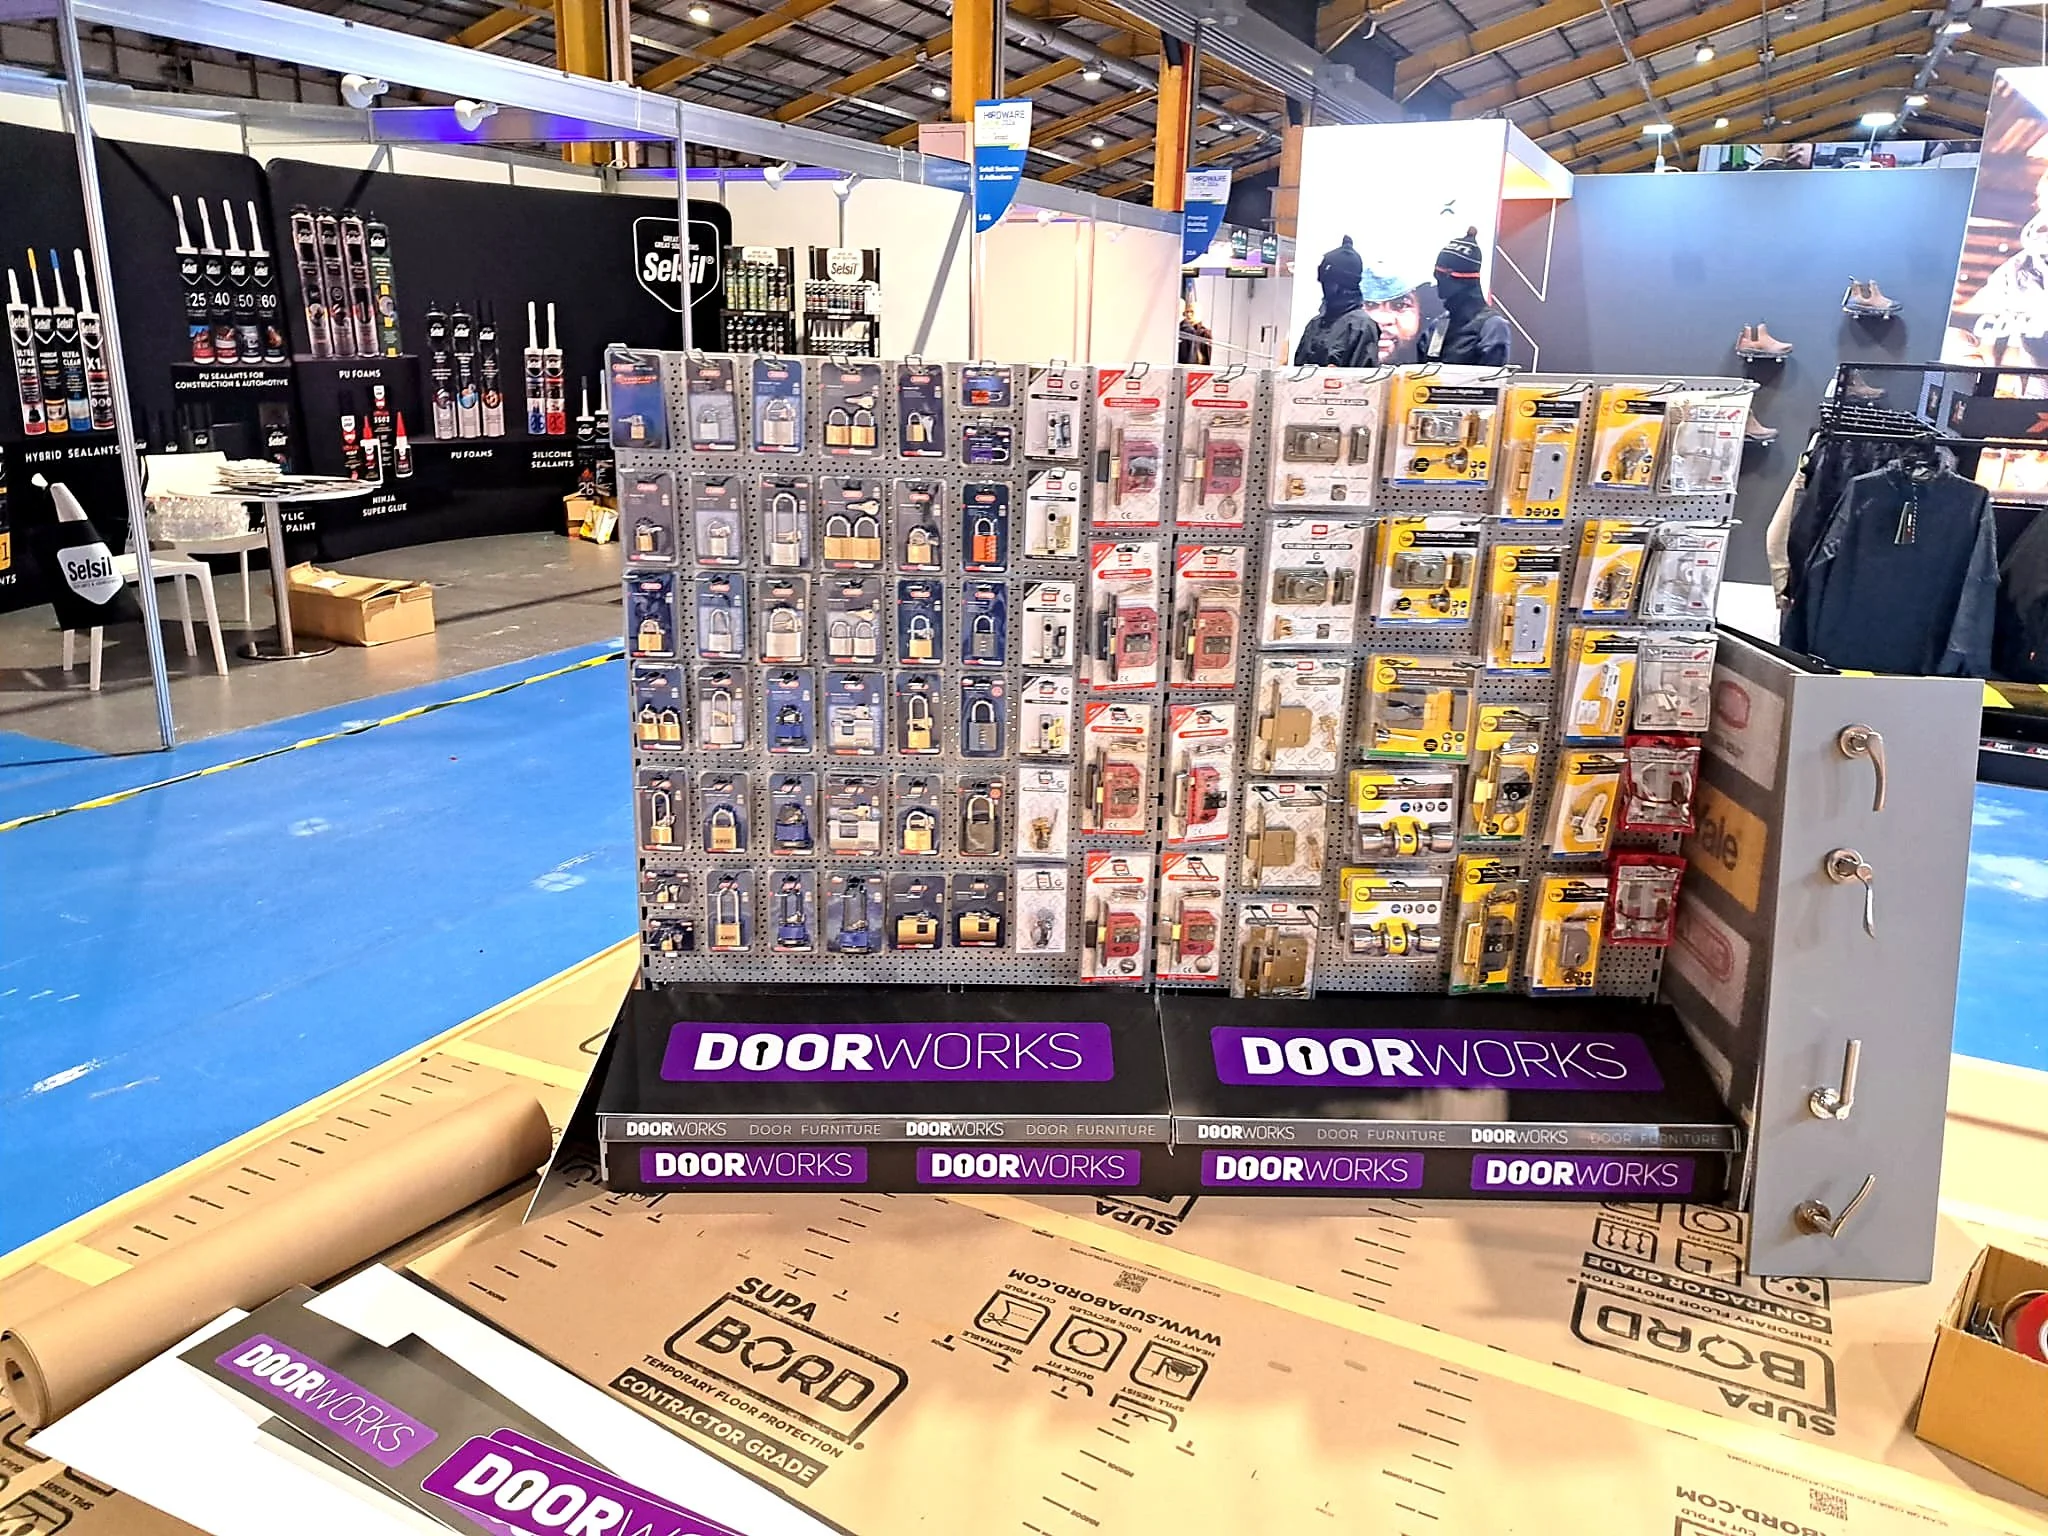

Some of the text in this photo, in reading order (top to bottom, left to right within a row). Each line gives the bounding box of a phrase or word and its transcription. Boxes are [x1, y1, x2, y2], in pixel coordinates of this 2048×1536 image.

[190, 292, 206, 307] 25
[214, 292, 230, 306] 40
[239, 294, 254, 307] 50
[261, 294, 277, 308] 60
[175, 381, 234, 389] CONSTRUCTION
[242, 379, 288, 387] AUTOMOTIVE
[211, 372, 248, 380] SEALANTS
[339, 369, 381, 379] PU FOAMS
[25, 445, 120, 463] HYBRID SEALANTS
[451, 450, 493, 459] PU FOAMS
[531, 460, 575, 469] SEALANTS
[532, 450, 573, 459] SILICONE
[362, 503, 407, 517] SUPER GLUE
[372, 494, 396, 504] NINJA
[286, 522, 316, 533] PAINT
[67, 556, 112, 581] Selsil
[693, 1031, 1083, 1072] DOORWORKS
[1241, 1036, 1628, 1080] DOORWORKS
[626, 1121, 1156, 1138] DOORWORKS DOOR FURNITURE DOORWORKS DOOR FURNITURE
[1198, 1124, 1296, 1140] DOORWORKS
[1317, 1128, 1358, 1140] DOOR
[1367, 1129, 1447, 1142] FURNITURE
[1471, 1128, 1568, 1145] DOORWORKS
[655, 1151, 853, 1179] DOORWORKS
[931, 1152, 1126, 1180] DOORWORKS
[1215, 1155, 1409, 1182] DOORWORKS
[1486, 1158, 1679, 1187] DOORWORKS
[1096, 1200, 1178, 1236] SUPA
[736, 1276, 819, 1323] SUPA
[1004, 1283, 1024, 1293] FOLD
[1036, 1293, 1056, 1304] CUT
[1587, 1255, 1828, 1329] CONTRACTOR GRADE
[1008, 1268, 1222, 1347] WWW.SUPABORD.COM
[1069, 1305, 1117, 1325] RECYCLED
[1580, 1271, 1834, 1347] TEMPORARY FLOOR PROTECTION
[961, 1330, 1023, 1355] BREATHABLE
[1153, 1332, 1216, 1358] HEAVY DUTY
[1046, 1360, 1095, 1381] QUICK FIT
[233, 1341, 415, 1454] DOORWORKS
[642, 1354, 844, 1459] TEMPORARY FLOOR PROTECTION
[1120, 1385, 1186, 1412] SPILL RESIST
[1718, 1386, 1837, 1437] SUPA
[617, 1374, 819, 1482] CONTRACTOR GRADE
[454, 1452, 718, 1536] DOOR
[1676, 1485, 1827, 1536] BORD.COM
[1681, 1507, 1715, 1523] FOLD
